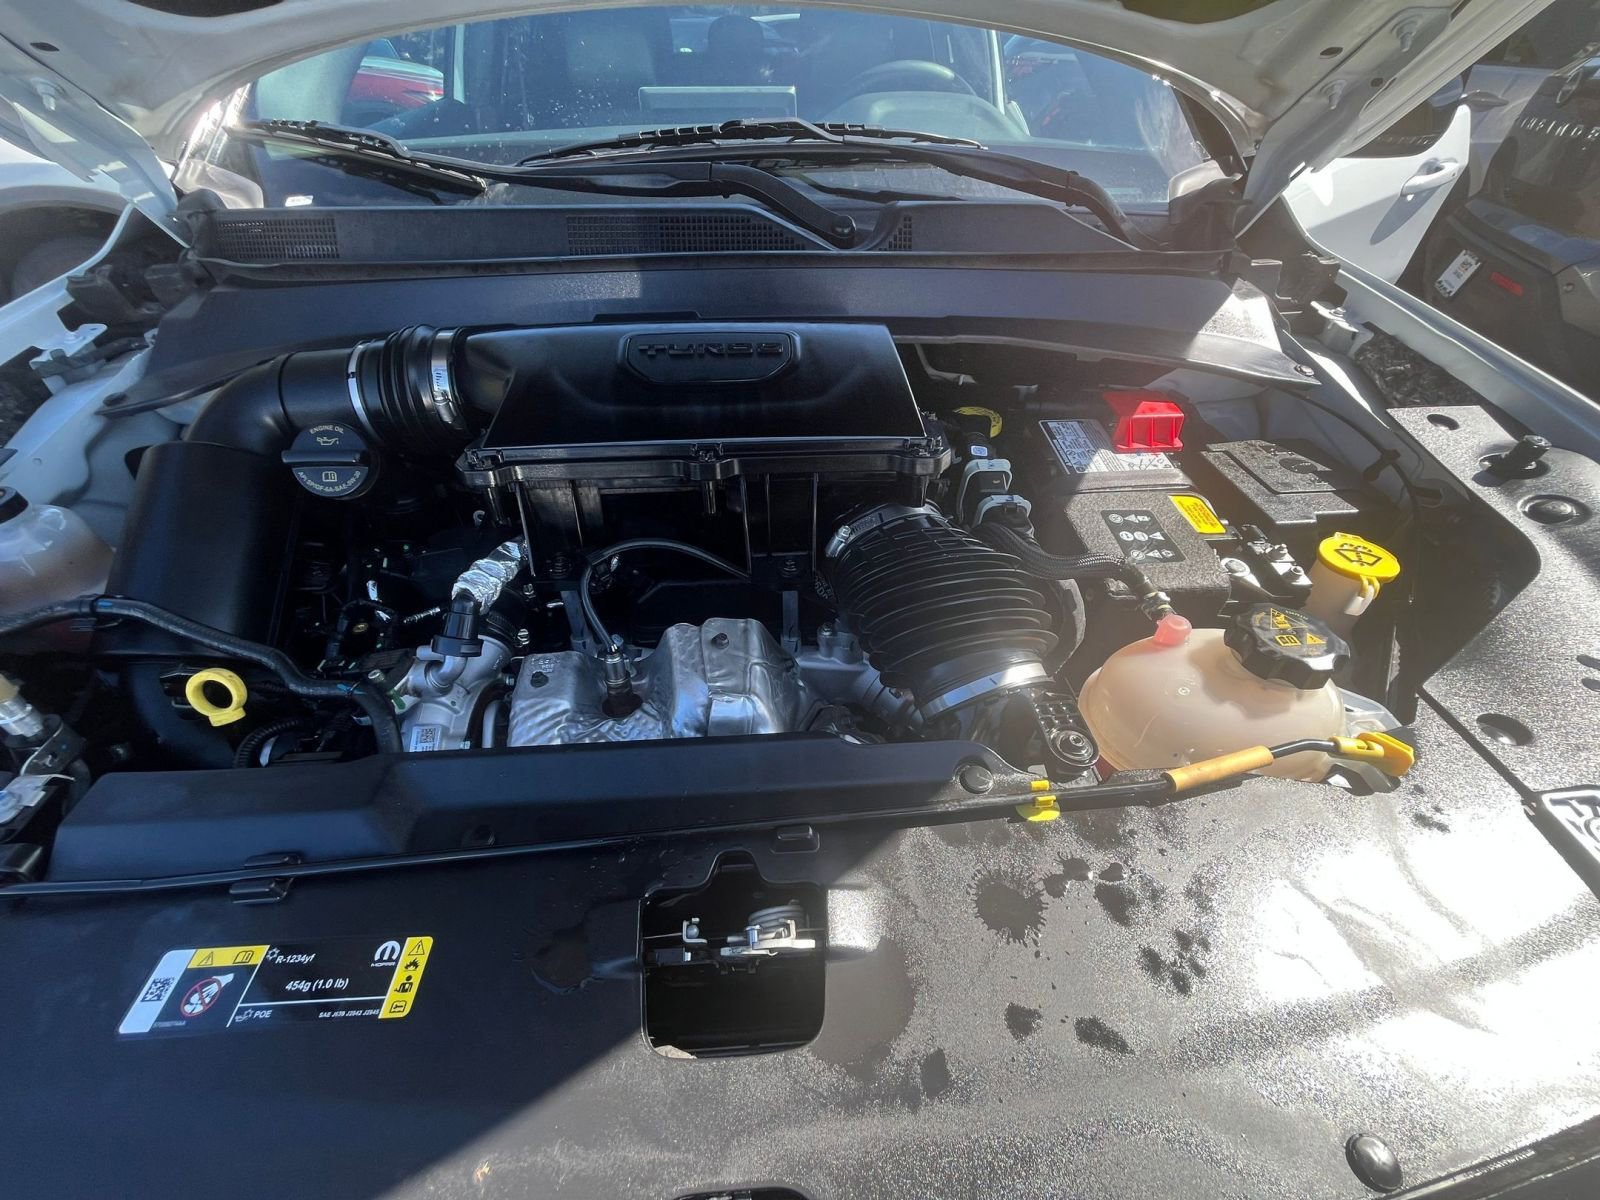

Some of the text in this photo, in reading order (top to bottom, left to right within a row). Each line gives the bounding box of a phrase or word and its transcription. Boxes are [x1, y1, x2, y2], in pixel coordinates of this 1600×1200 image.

[638, 343, 783, 356] TURBO
[309, 424, 345, 435] ENGINE OIL
[275, 953, 315, 965] R-1234yf
[285, 977, 349, 992] 454g (1.0 lb)
[253, 1009, 272, 1018] POE
